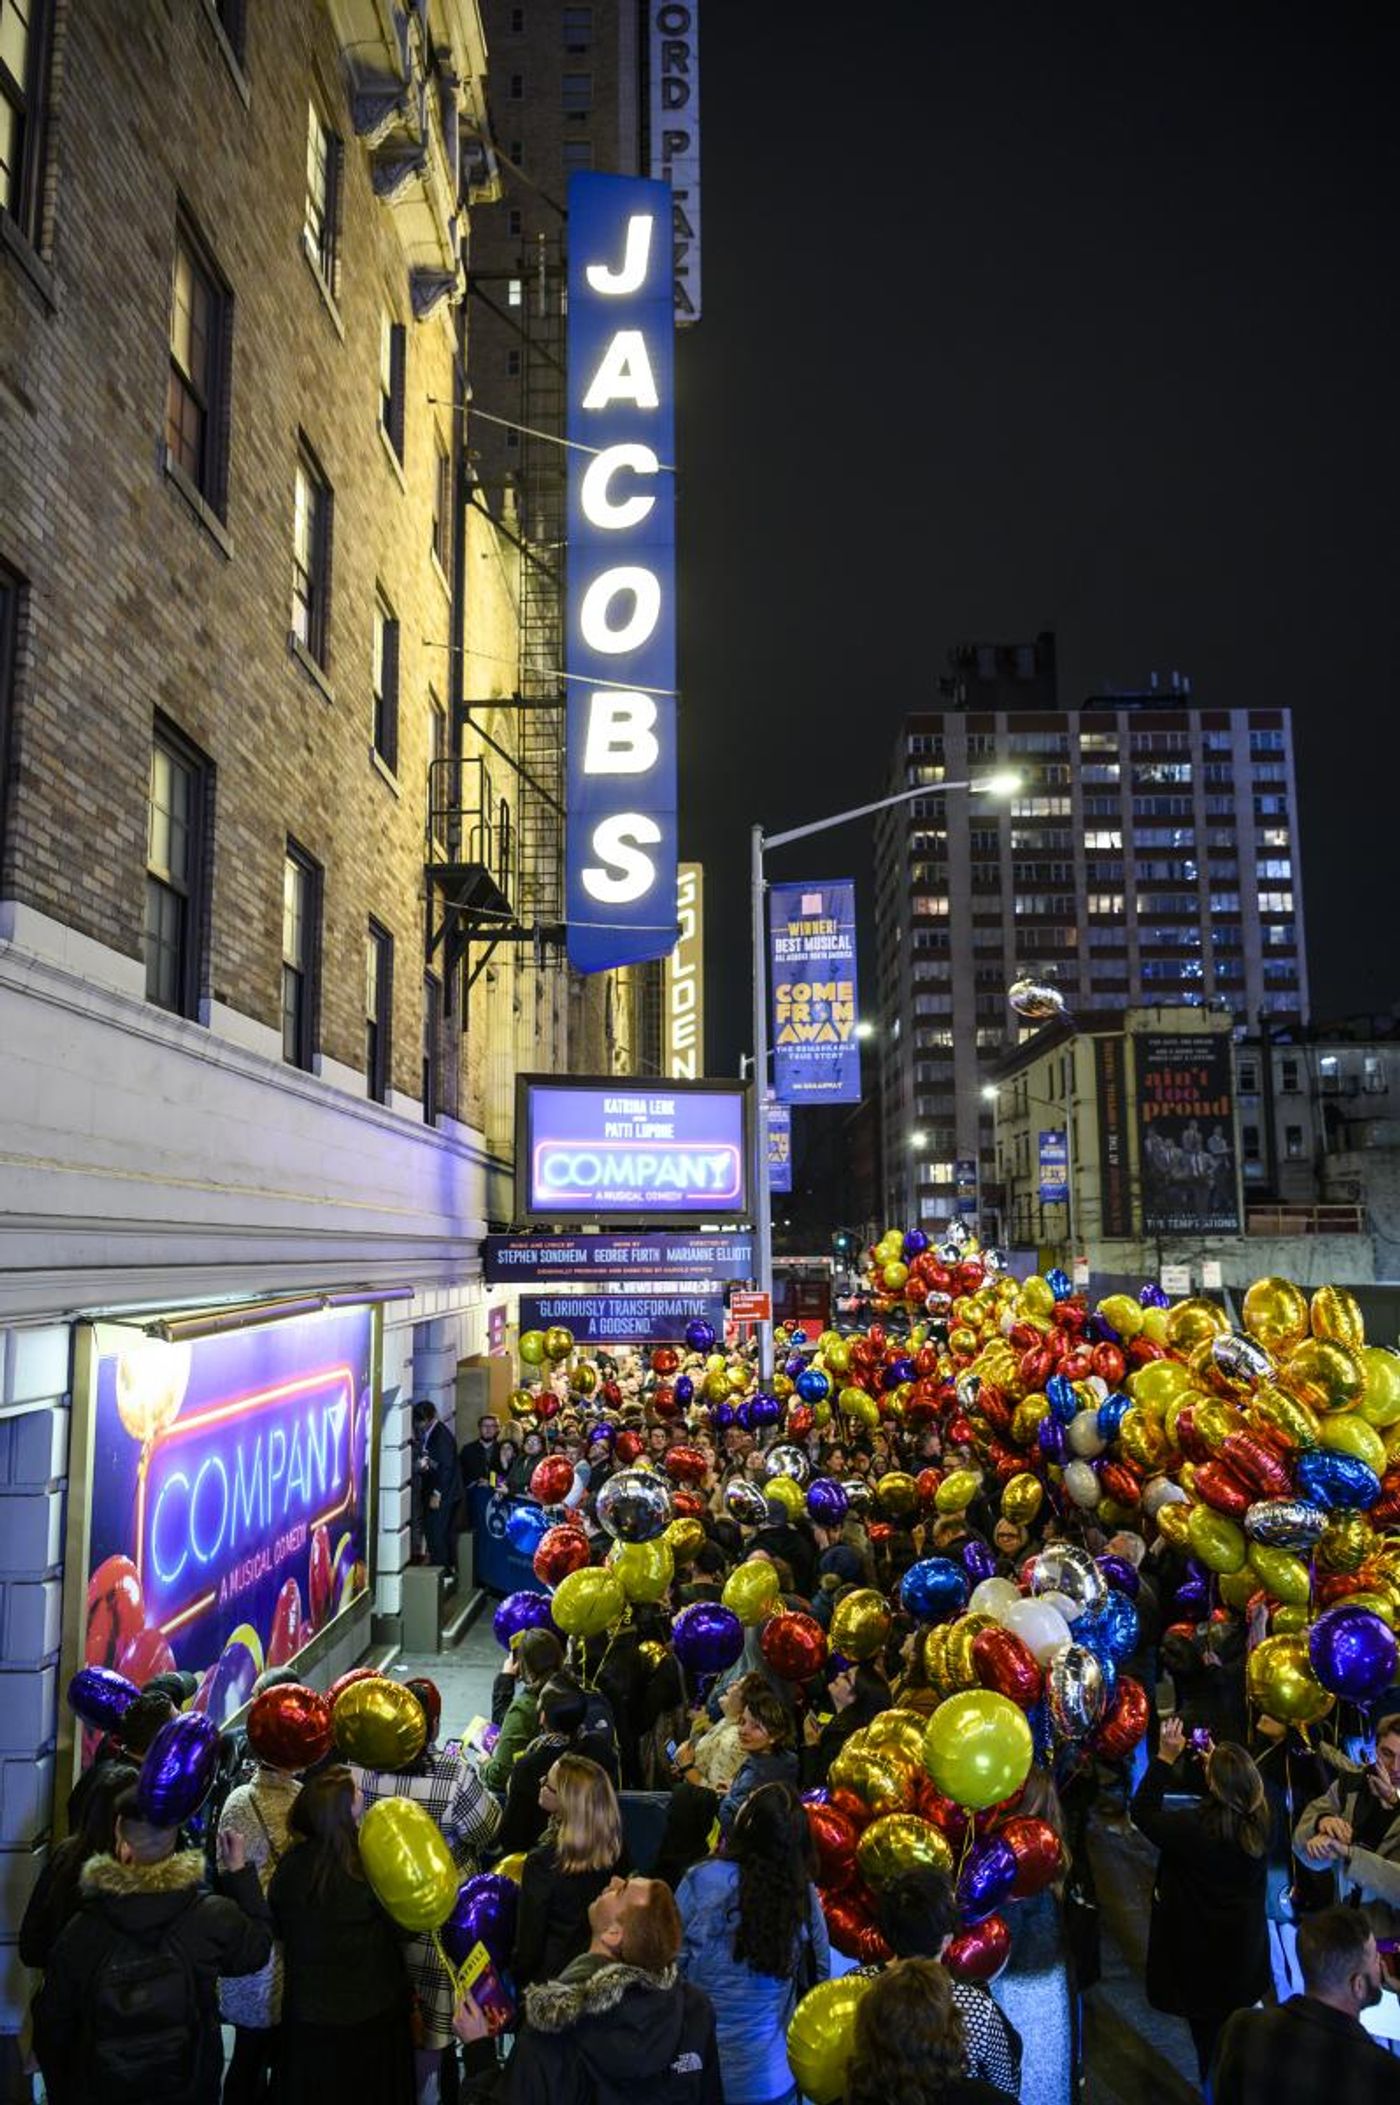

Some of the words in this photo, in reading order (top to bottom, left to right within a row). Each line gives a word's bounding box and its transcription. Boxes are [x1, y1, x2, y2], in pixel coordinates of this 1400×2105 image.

[656, 0, 691, 110] ORD
[580, 215, 662, 903] JACOBS
[775, 937, 801, 953] BEST
[804, 935, 852, 951] MUSICAL
[672, 871, 696, 1079] GOLDEN
[776, 981, 854, 1003] COME
[776, 1002, 854, 1024] FROM
[777, 1021, 854, 1044] AWAY
[1145, 1067, 1209, 1087] ain't
[1155, 1086, 1199, 1101] too
[1142, 1095, 1230, 1122] proud
[605, 1122, 633, 1138] PATTI
[1108, 1135, 1118, 1151] THE
[1108, 1153, 1119, 1165] AT
[543, 1151, 731, 1189] COMPANY
[603, 1191, 644, 1202] MUSICAL
[498, 1249, 538, 1264] STEPHEN
[540, 1248, 588, 1263] SONDHEIM
[594, 1248, 629, 1262] GEORGE
[631, 1247, 660, 1262] FURTH
[667, 1247, 715, 1262] MARIANNE
[716, 1246, 752, 1261] ELLIOTT
[588, 1318, 597, 1334] A
[152, 1388, 348, 1582] COMPANY
[220, 1576, 228, 1604] A
[229, 1548, 273, 1597] MUSICAL
[274, 1522, 307, 1563] COMEDY
